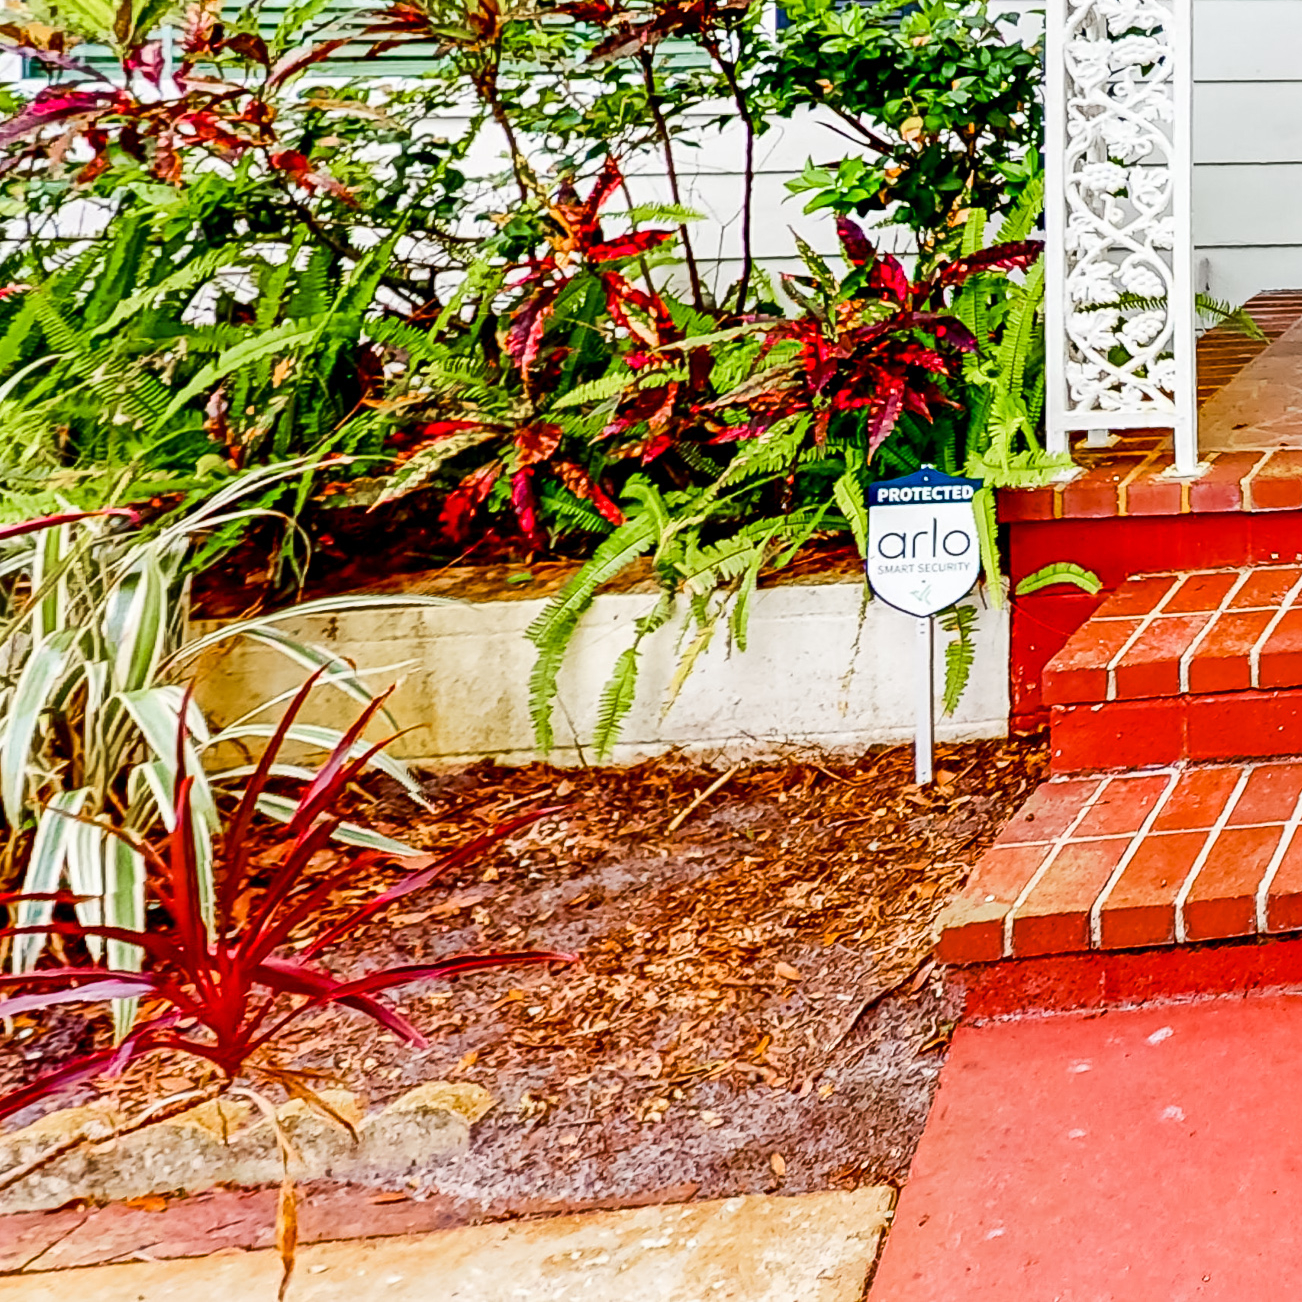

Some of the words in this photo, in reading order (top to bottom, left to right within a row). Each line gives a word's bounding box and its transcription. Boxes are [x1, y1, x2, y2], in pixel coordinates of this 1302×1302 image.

[877, 485, 974, 502] PROTECTED
[878, 517, 970, 559] arlo
[877, 564, 914, 574] SMART
[918, 562, 970, 573] SECURITY
